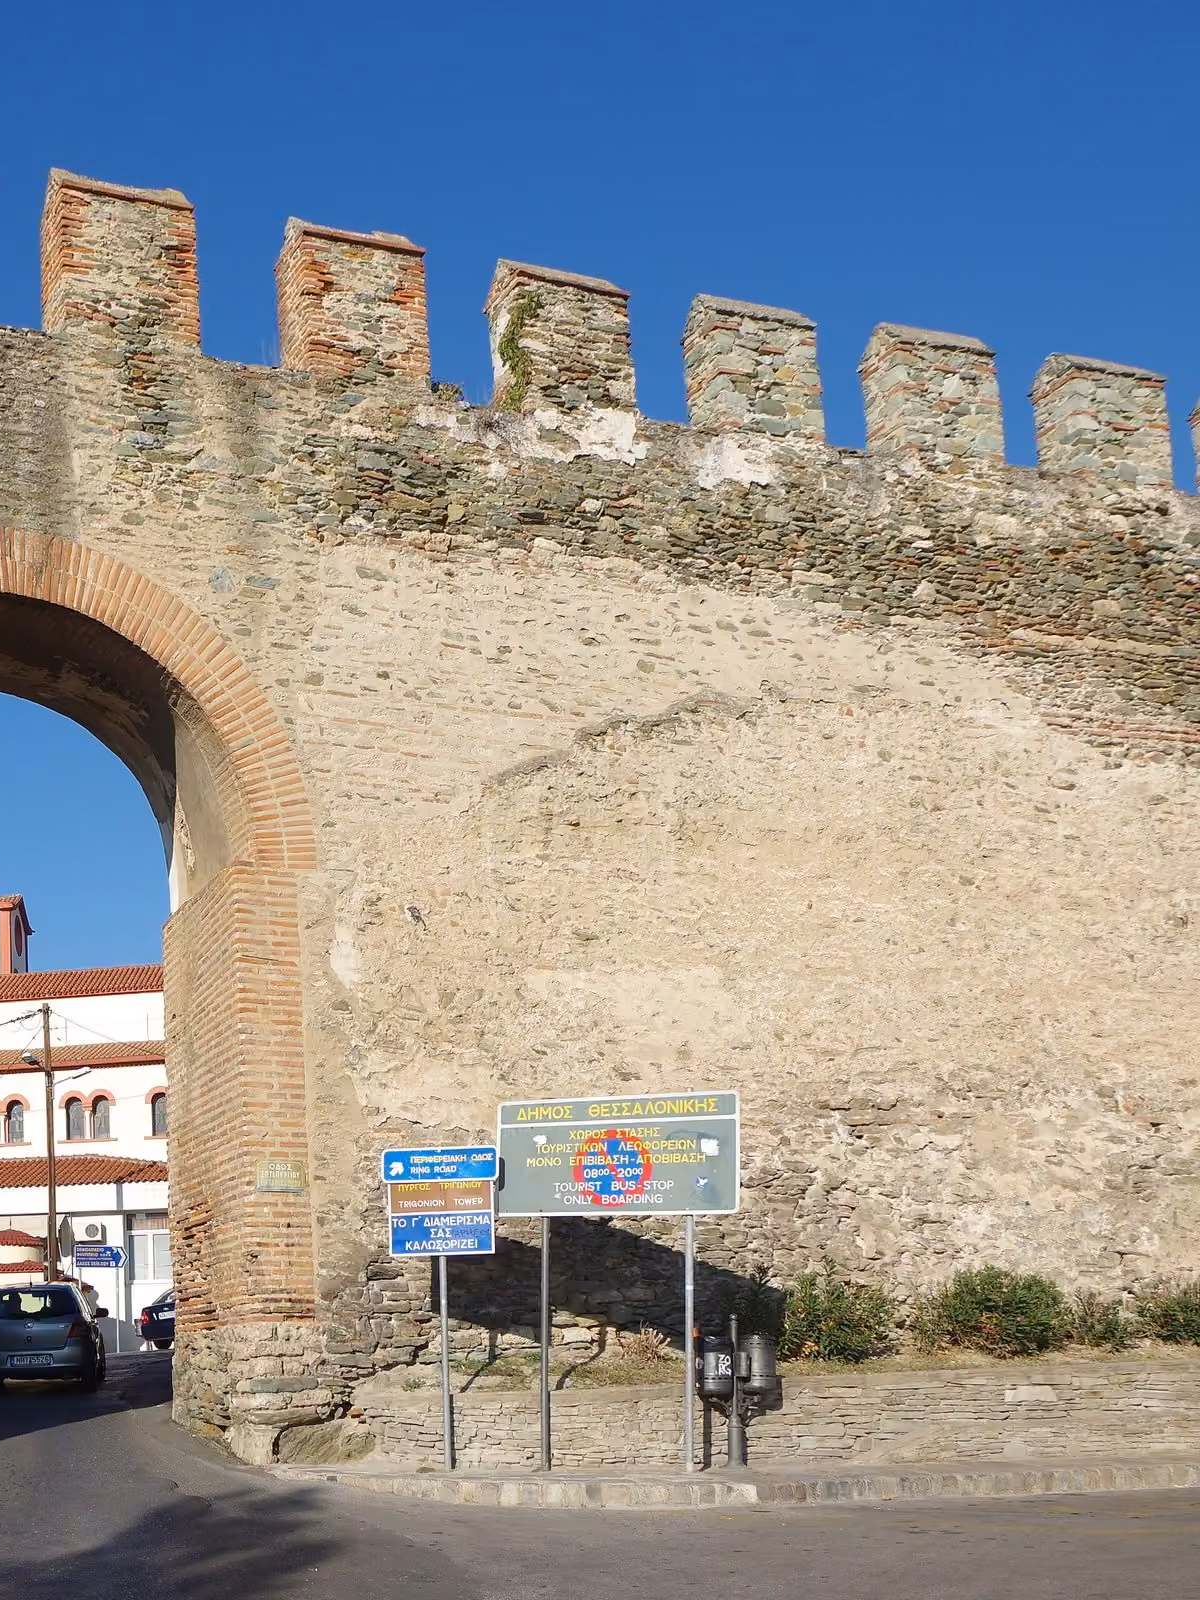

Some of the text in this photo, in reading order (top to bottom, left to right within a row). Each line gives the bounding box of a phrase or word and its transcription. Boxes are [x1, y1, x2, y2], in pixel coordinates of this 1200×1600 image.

[516, 1098, 719, 1121] ΔΗΜΟΣ ΘΕΣΣΑΛΟΝΙΚΗΣ
[569, 1127, 661, 1140] ΧΩΡΟΣ ΣΤΑΣΗΣ
[536, 1139, 696, 1154] ΤΟΥΡΙΣΤΙΚΩΝ ΛΕΩΦΟΡΕΙΩΝ
[410, 1154, 467, 1164] ΠΕΡΙΦΕΡΕΙΑΚΗ
[526, 1157, 561, 1167] ΜΟΝΟ
[410, 1165, 457, 1174] RING ROAD
[398, 1181, 483, 1192] ΠΥΡΓΟΣ ΤΡΙΓΩΝΙΟΥ
[553, 1181, 602, 1192] TOURIST
[398, 1197, 484, 1208] TRIGONION TOWER
[564, 1193, 663, 1205] ONLY BOARDING
[392, 1218, 407, 1228] ΤΟ
[423, 1215, 491, 1227] ΔΙΑΜΕΡΙΣΜΑ
[430, 1228, 452, 1238] ΣΑΣ
[405, 1239, 478, 1251] ΚΑΛΩΣΟΡΙΖΕΙ
